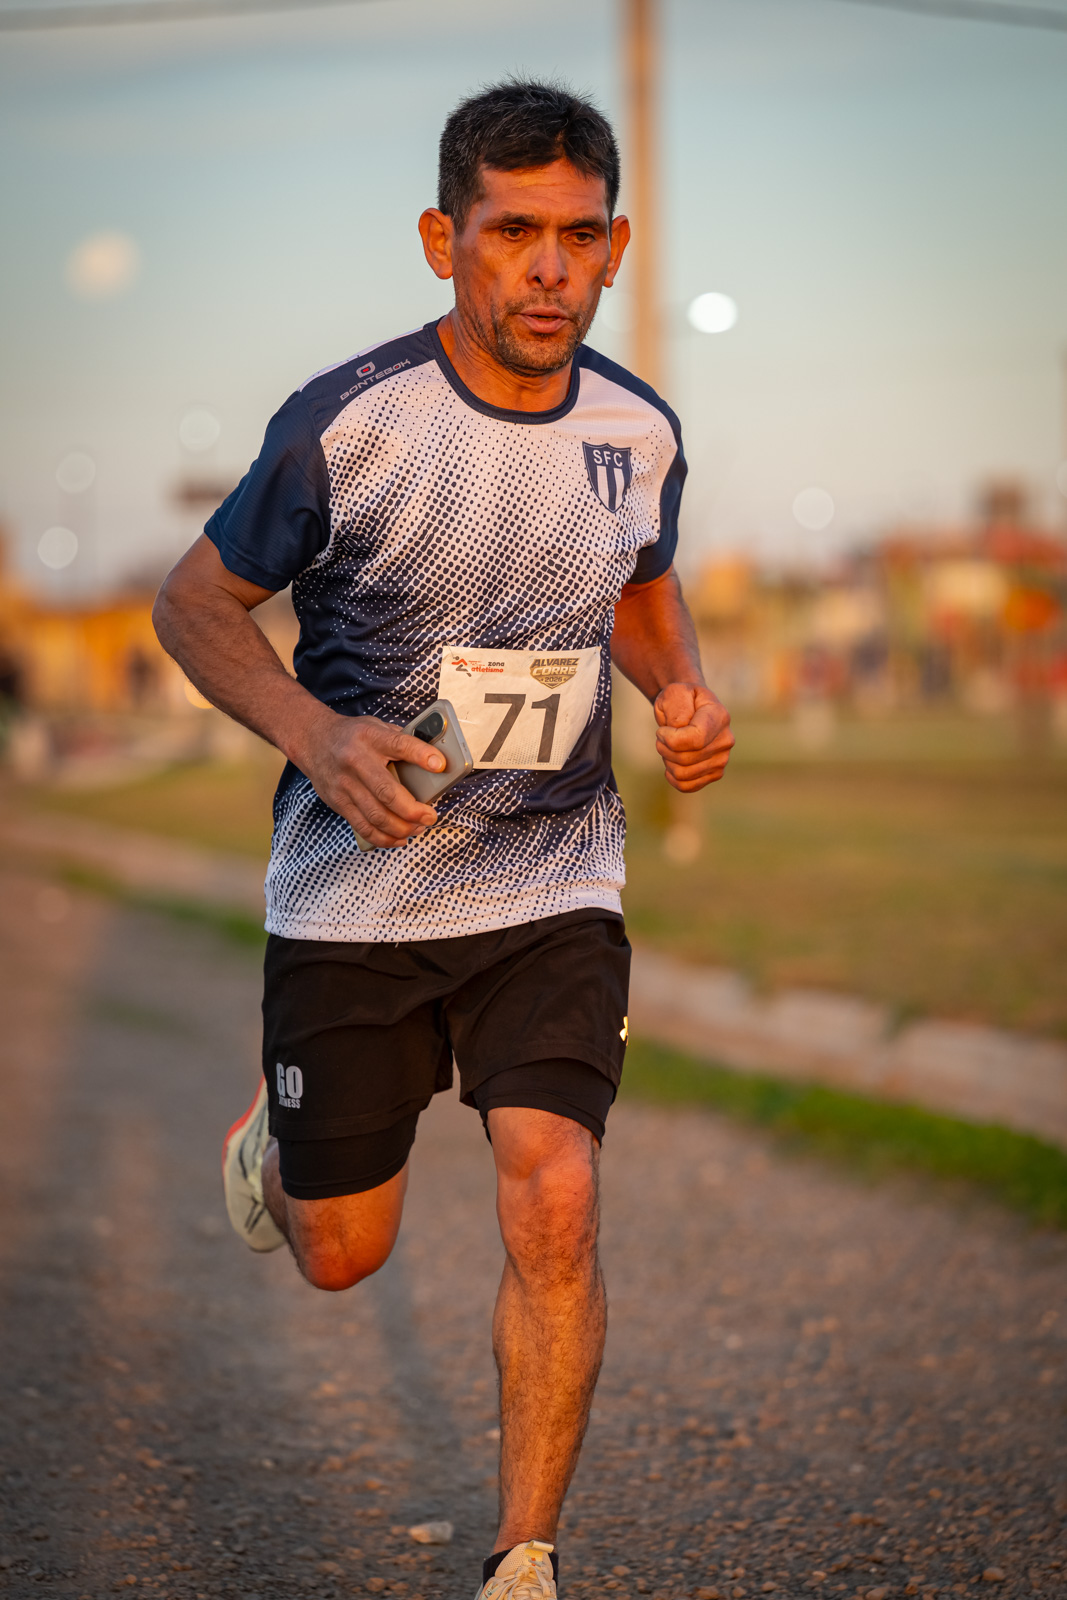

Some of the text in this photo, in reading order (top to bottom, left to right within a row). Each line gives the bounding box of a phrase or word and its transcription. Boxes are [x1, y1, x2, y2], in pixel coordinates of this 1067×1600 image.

[340, 358, 411, 401] BONTEBOK
[592, 449, 623, 468] SFC
[530, 658, 579, 668] ALVAREZ
[532, 666, 577, 676] CORRE
[479, 693, 561, 763] 71
[276, 1062, 303, 1099] GO
